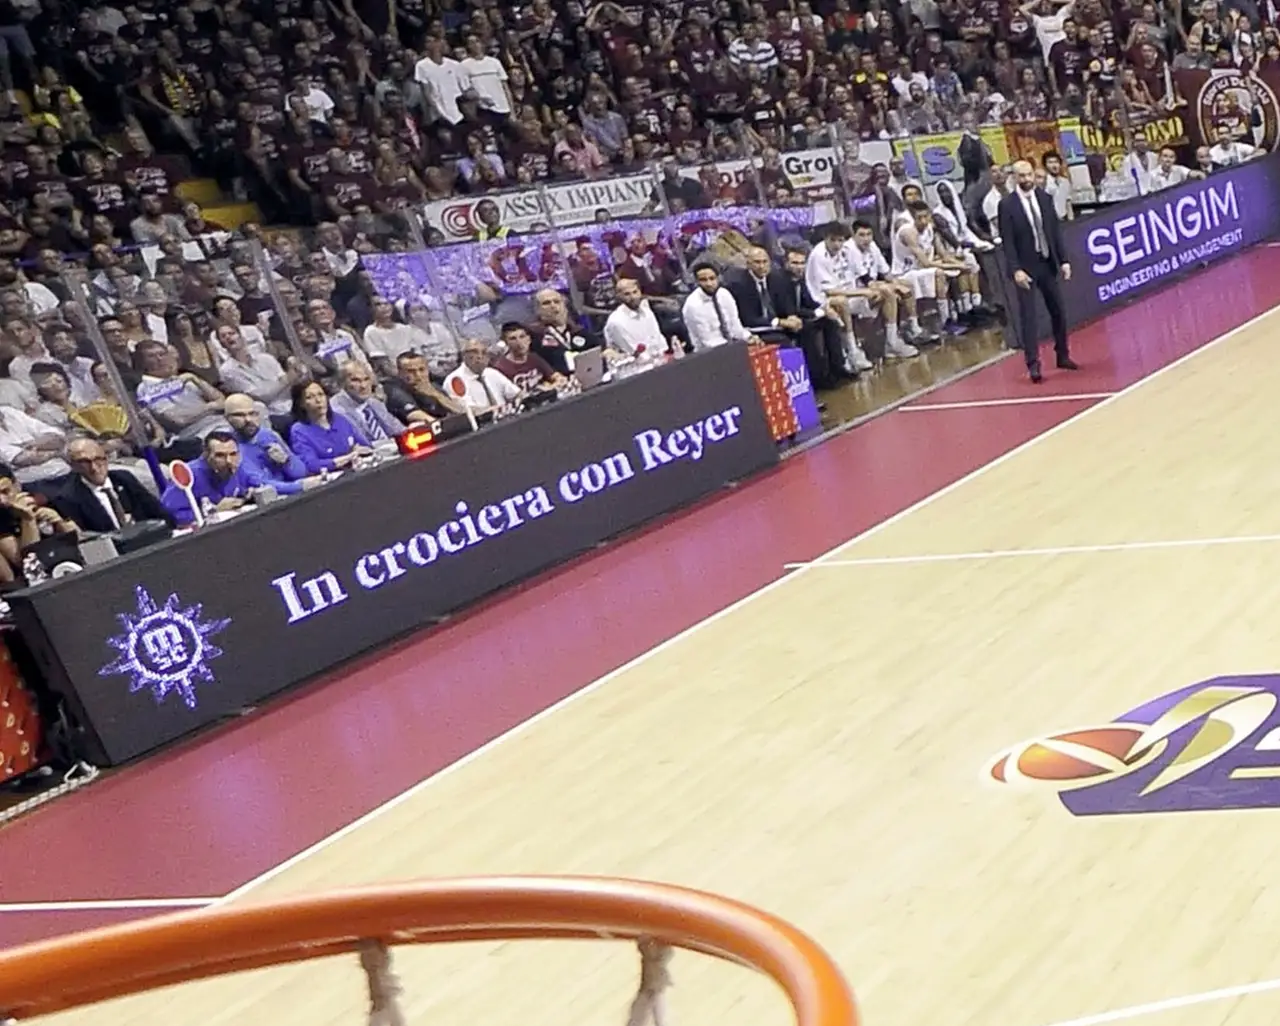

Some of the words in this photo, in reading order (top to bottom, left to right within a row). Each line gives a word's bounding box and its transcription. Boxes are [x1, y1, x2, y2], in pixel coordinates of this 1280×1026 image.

[1087, 180, 1240, 275] SEINGIM
[1098, 259, 1171, 302] ENGINEERING
[1179, 228, 1243, 266] MANAGEMENT
[271, 569, 349, 625] In
[355, 487, 555, 591] crociera
[558, 457, 636, 504] con
[633, 403, 744, 472] Reyer
